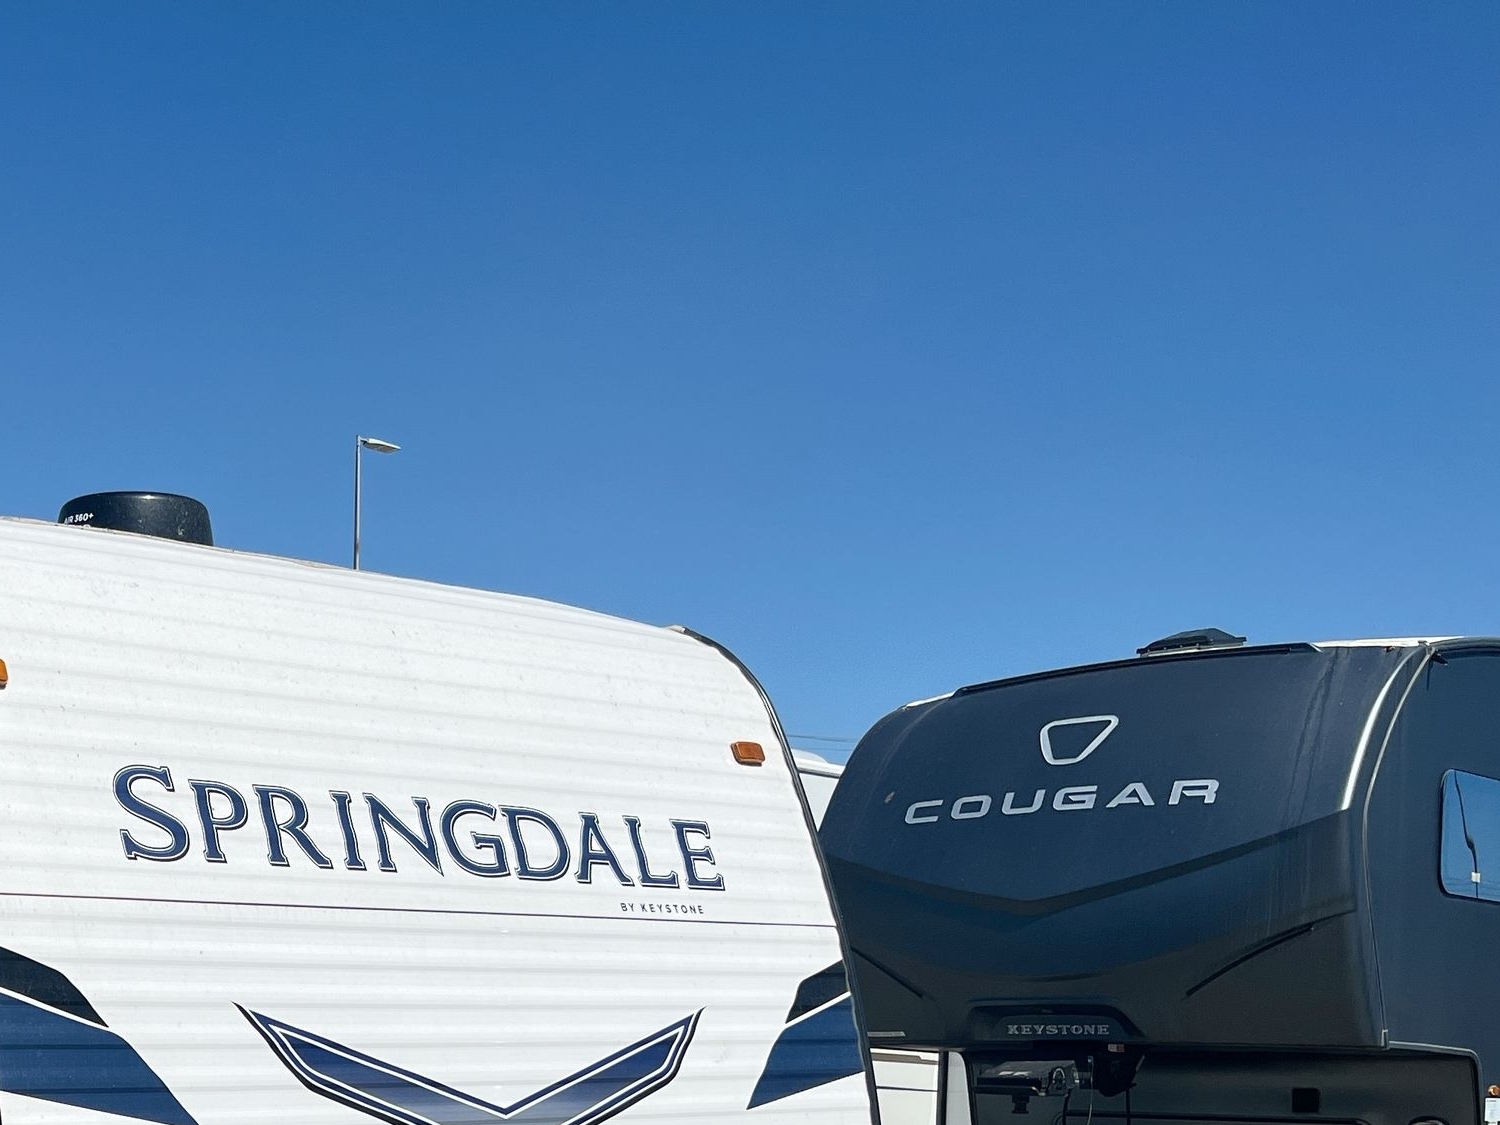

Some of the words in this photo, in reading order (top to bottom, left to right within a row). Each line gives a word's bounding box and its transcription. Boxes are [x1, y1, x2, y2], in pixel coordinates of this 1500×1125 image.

[904, 779, 1220, 825] COUGAR
[111, 764, 726, 892] SPRINGDALE
[620, 902, 634, 912] BY
[640, 903, 704, 914] KEYSTONE
[1007, 1024, 1109, 1035] KEYSTONE
